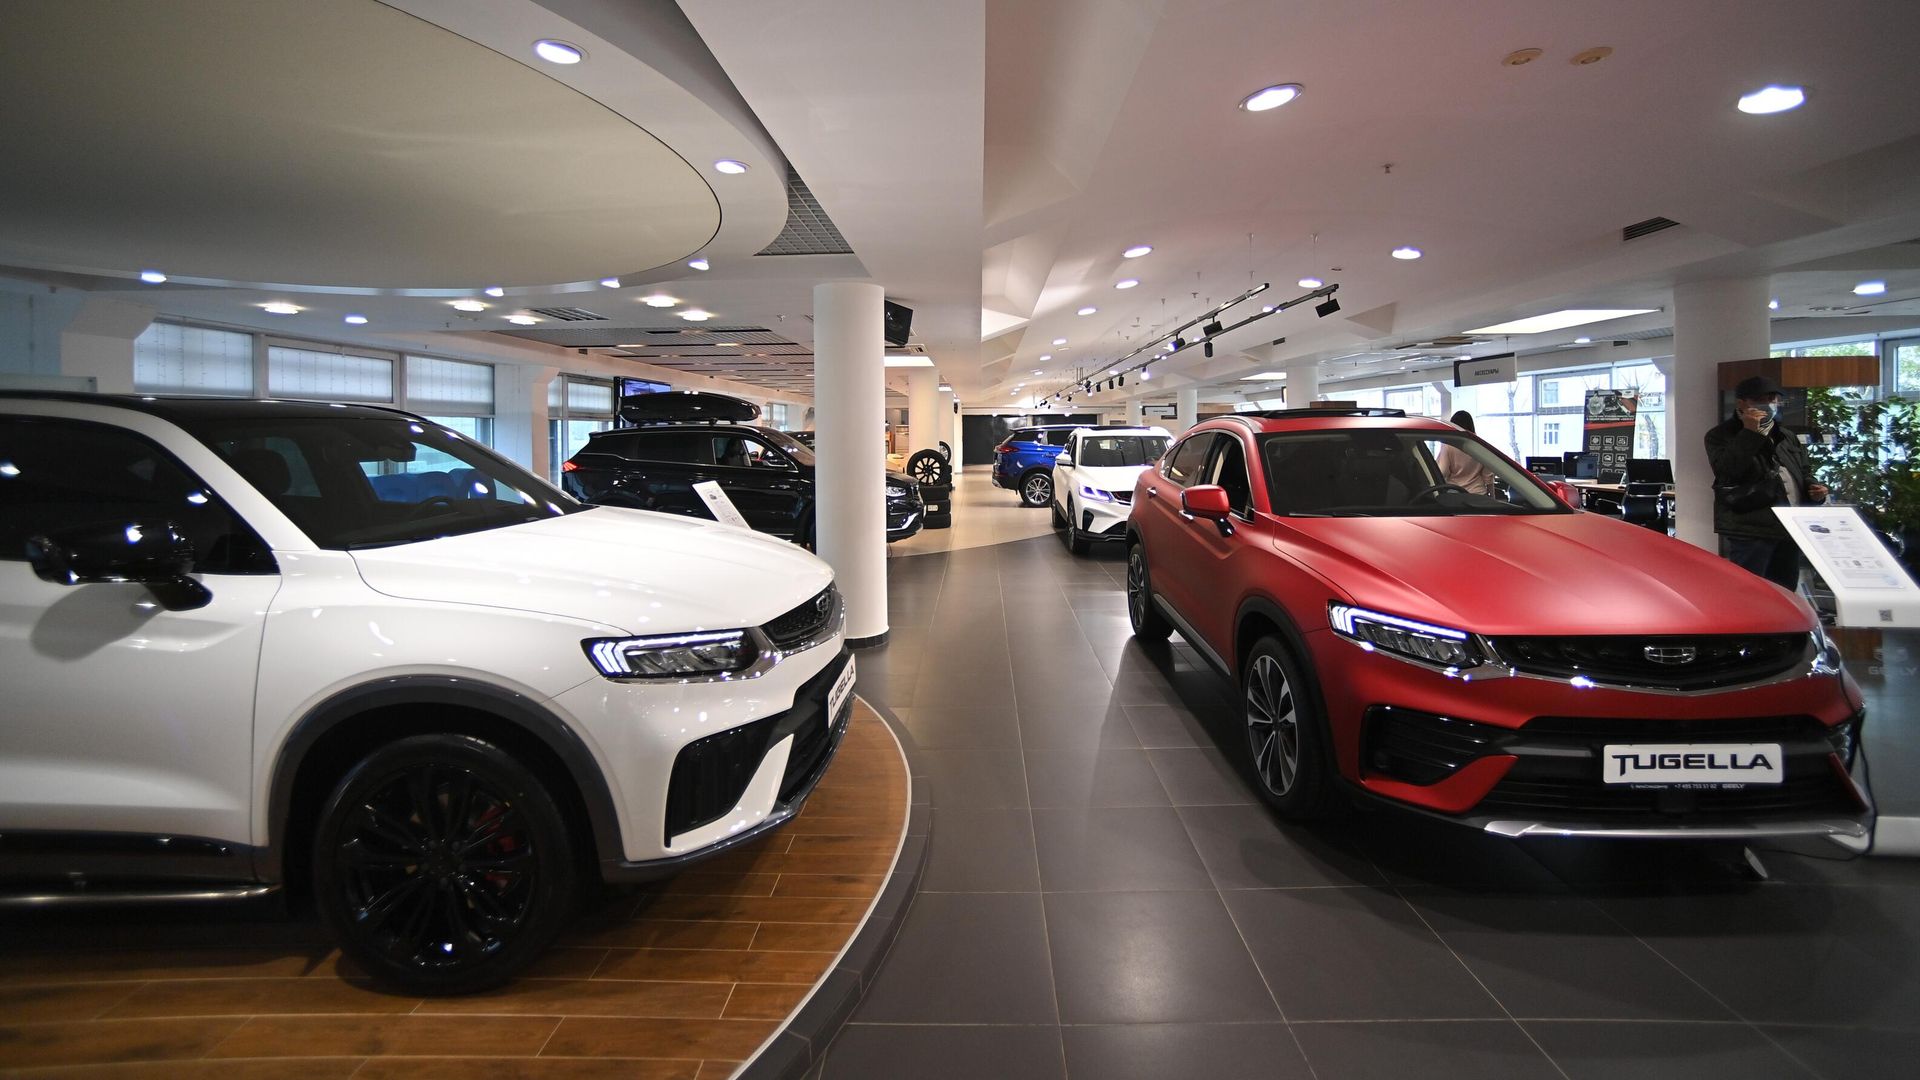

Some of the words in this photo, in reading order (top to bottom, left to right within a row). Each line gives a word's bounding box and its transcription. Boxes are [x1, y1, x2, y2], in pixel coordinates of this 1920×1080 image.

[1868, 666, 1917, 676] GELY
[829, 665, 855, 717] TUGELLA
[1611, 753, 1774, 777] TUGELLA
